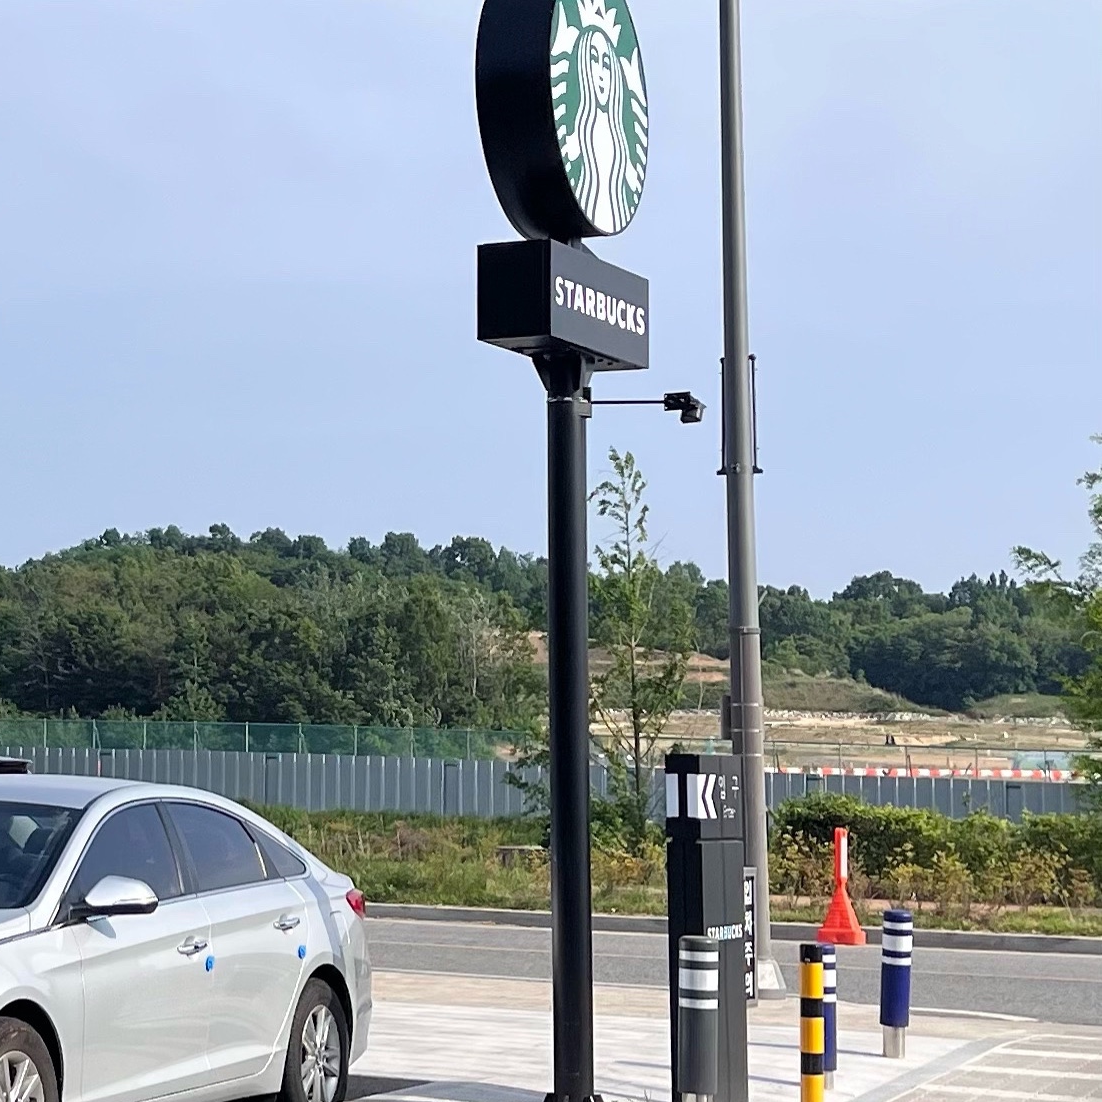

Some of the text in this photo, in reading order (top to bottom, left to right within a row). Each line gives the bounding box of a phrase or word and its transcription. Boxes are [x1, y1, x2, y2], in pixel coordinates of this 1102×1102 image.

[555, 276, 645, 336] STARBUCKS
[718, 774, 739, 800] 입구
[707, 923, 743, 940] STARBUCKS
